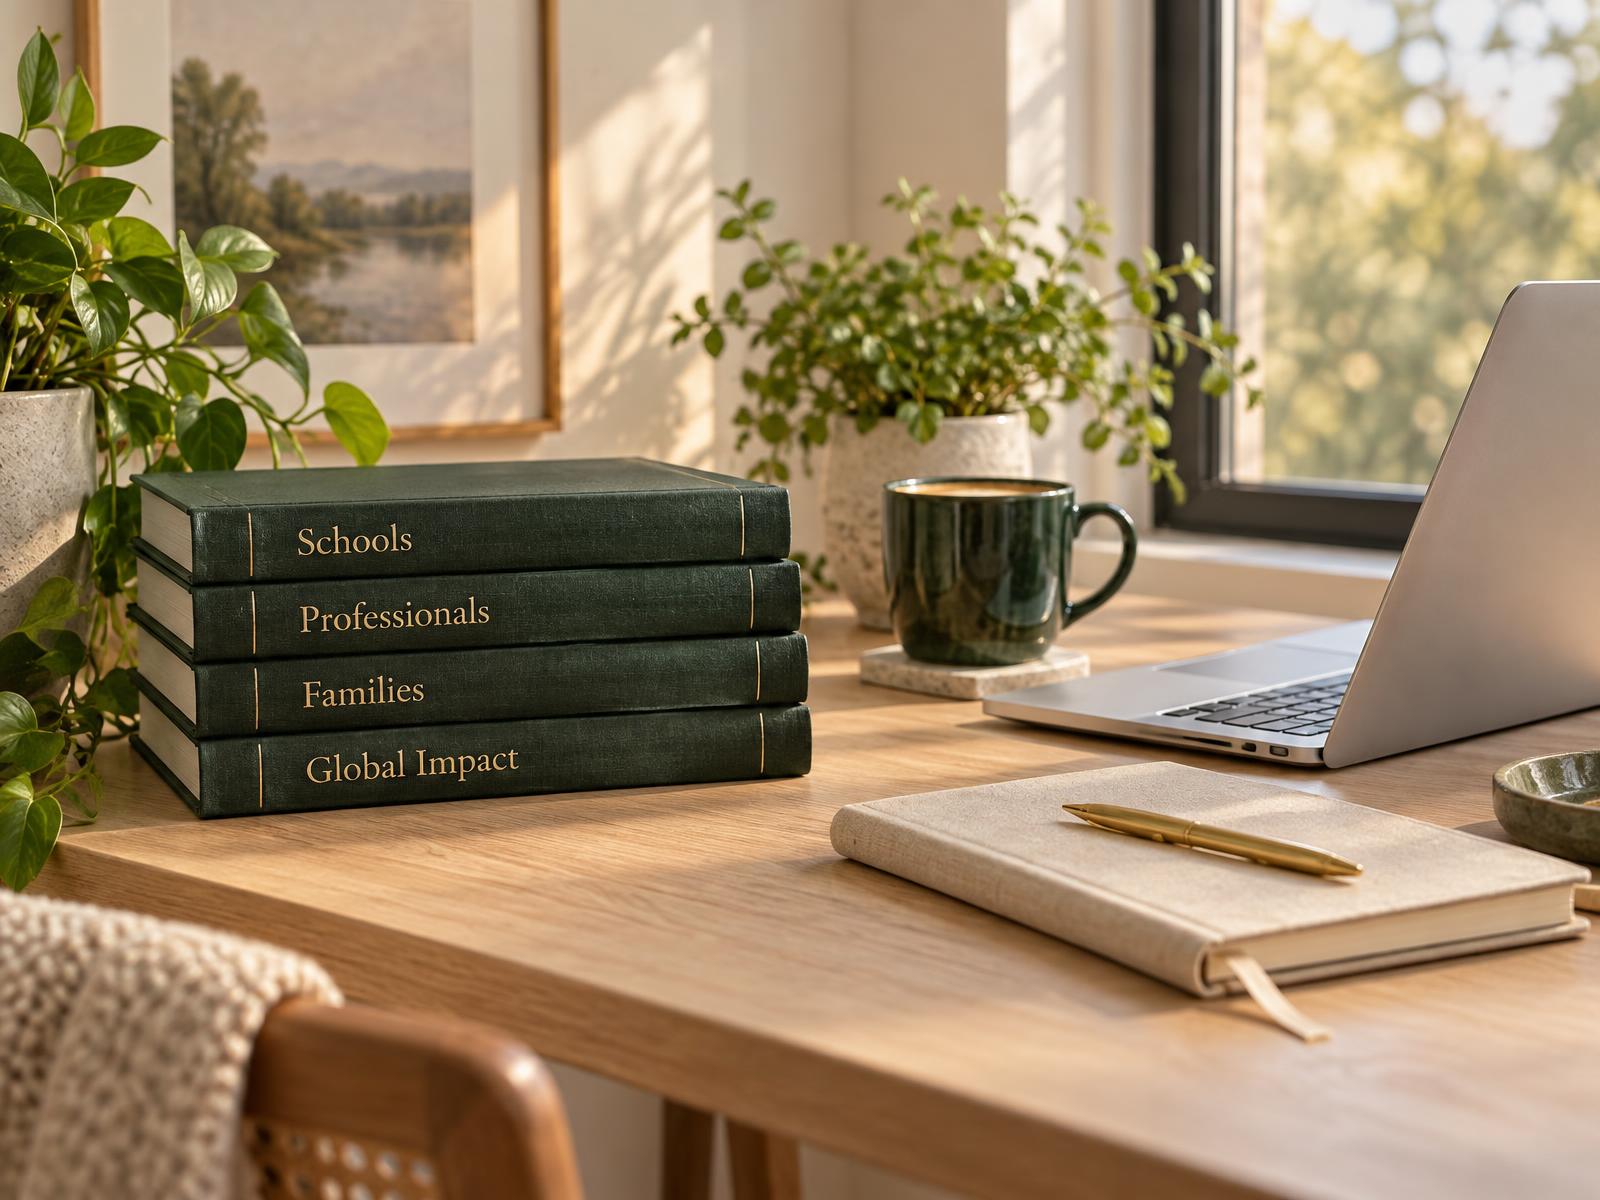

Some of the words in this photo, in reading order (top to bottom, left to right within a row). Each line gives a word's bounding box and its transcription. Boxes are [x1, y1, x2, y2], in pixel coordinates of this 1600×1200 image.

[297, 523, 412, 556] Schools
[300, 596, 490, 633] Professionals
[302, 675, 424, 708] Families
[306, 749, 405, 784] Global
[416, 748, 519, 782] Impact
